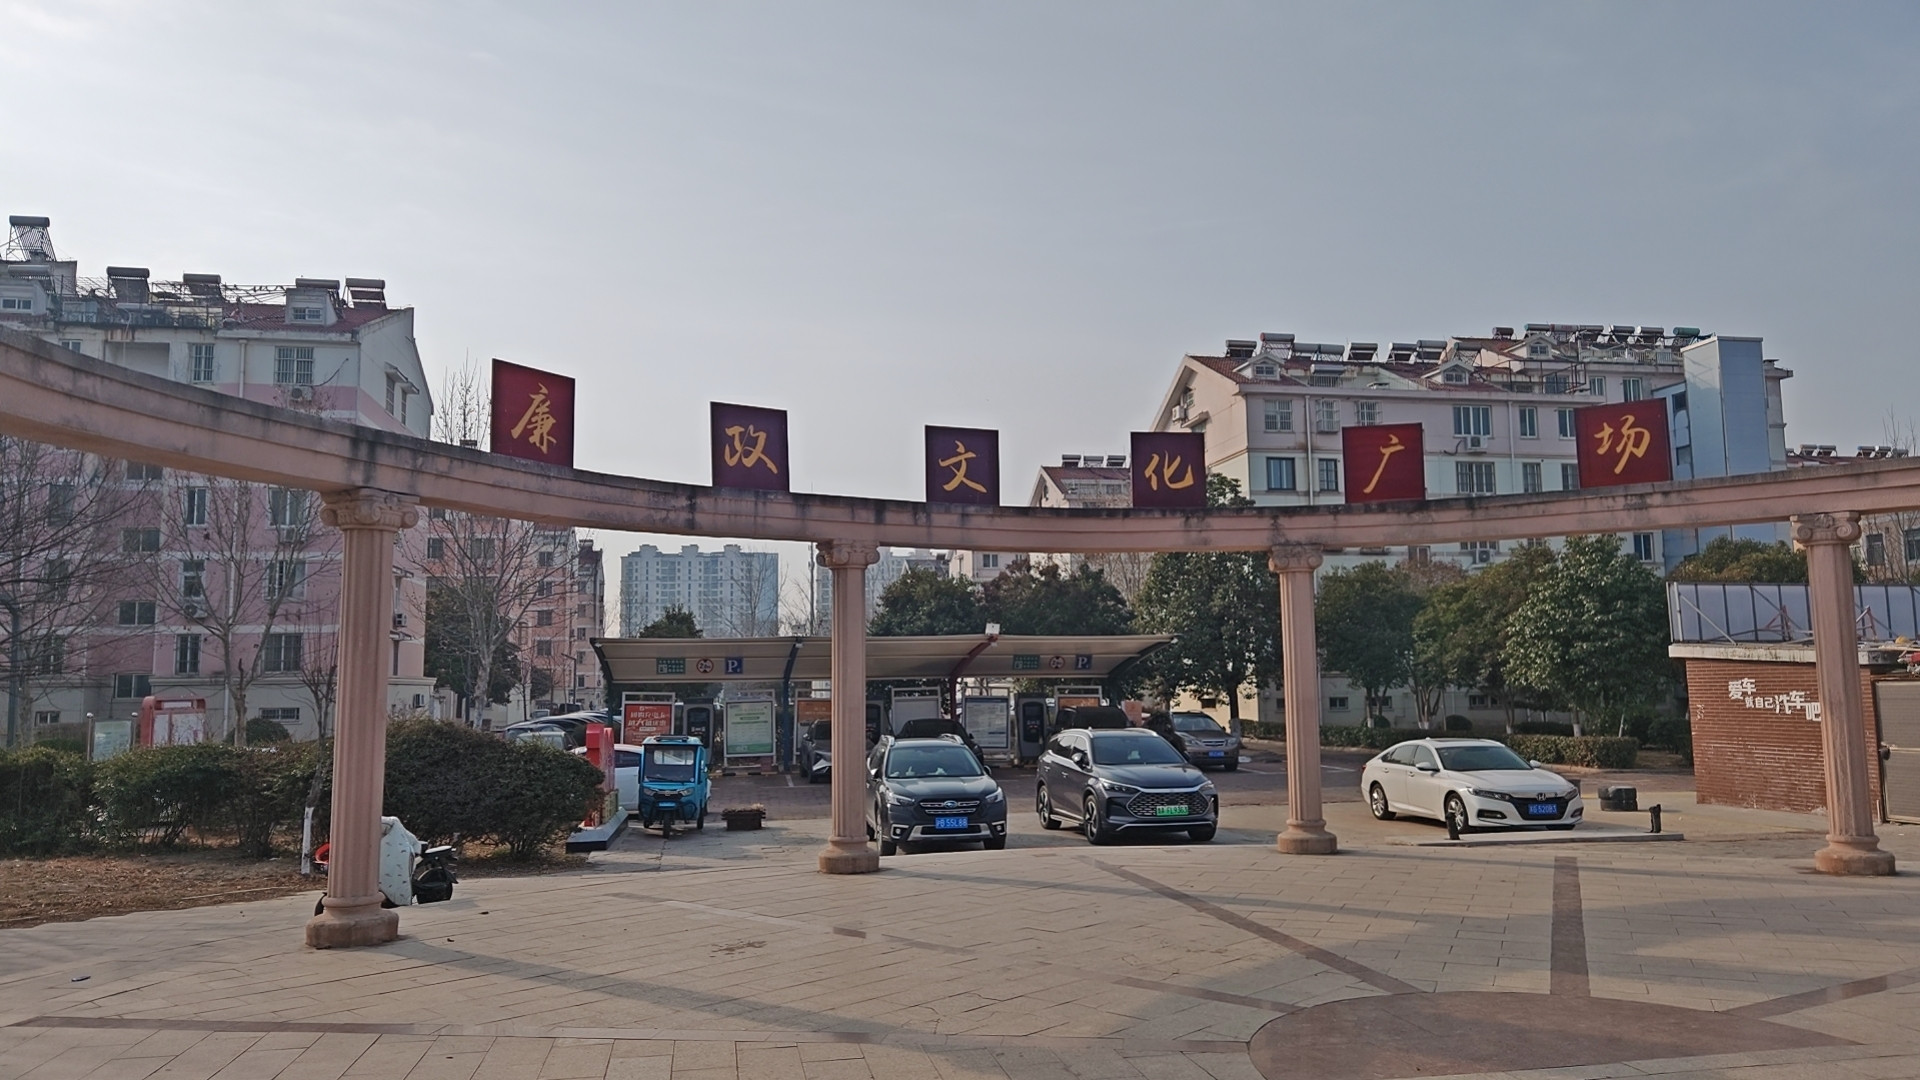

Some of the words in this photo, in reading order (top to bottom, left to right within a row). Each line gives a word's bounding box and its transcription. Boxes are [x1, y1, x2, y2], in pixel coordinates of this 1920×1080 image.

[510, 381, 557, 454] 廉
[723, 424, 778, 474] 政
[939, 440, 987, 493] 文
[1143, 450, 1194, 491] 化
[1362, 433, 1406, 494] 广
[1593, 414, 1651, 475] 场
[1728, 677, 1757, 700] 爱车
